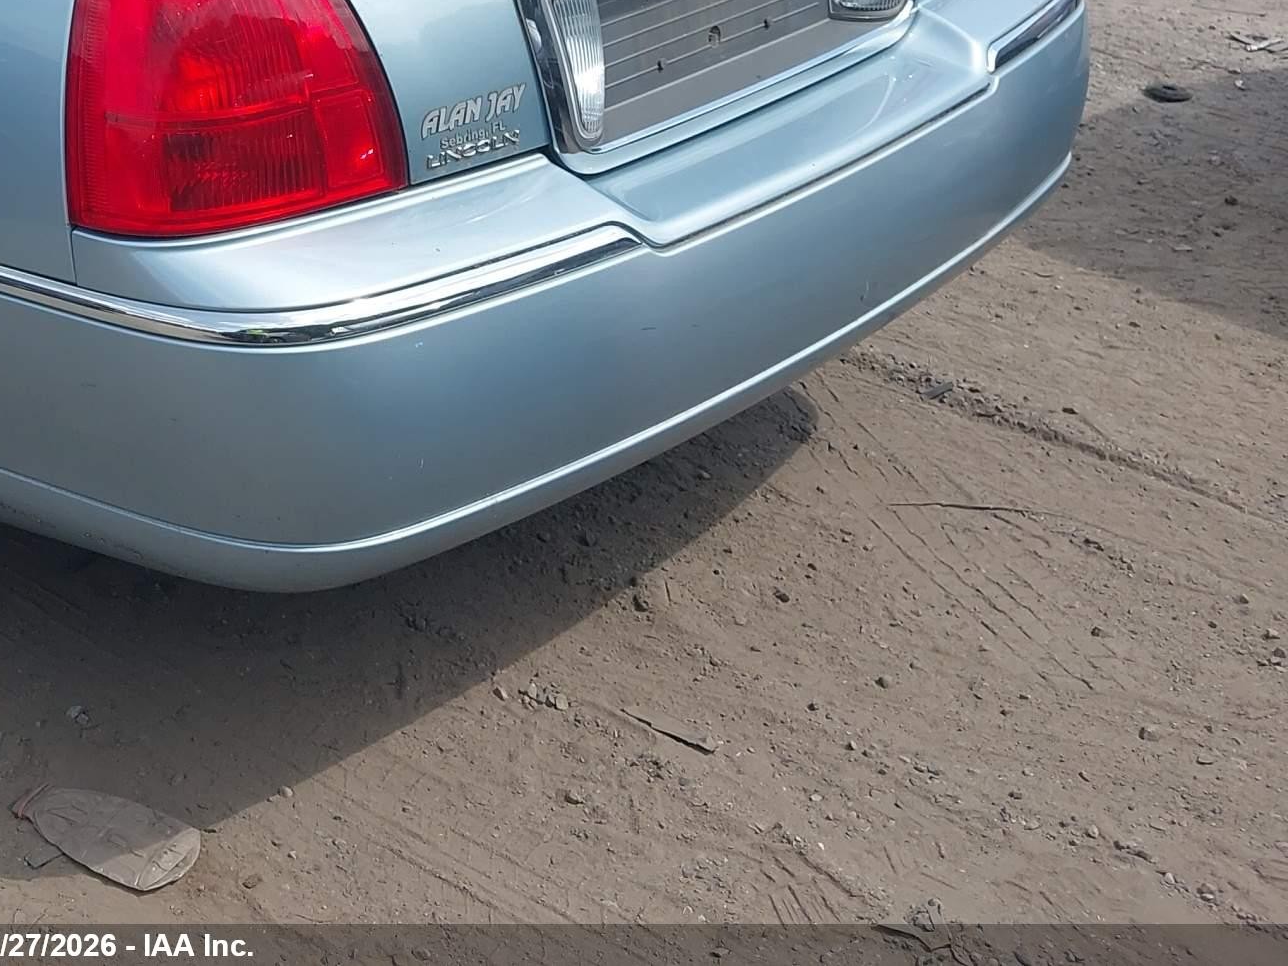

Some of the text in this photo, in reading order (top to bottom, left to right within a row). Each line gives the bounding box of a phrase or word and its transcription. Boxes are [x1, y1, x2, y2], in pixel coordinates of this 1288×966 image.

[421, 82, 526, 140] ALAN JAY
[492, 120, 506, 133] FL
[426, 129, 519, 168] LINCOLN
